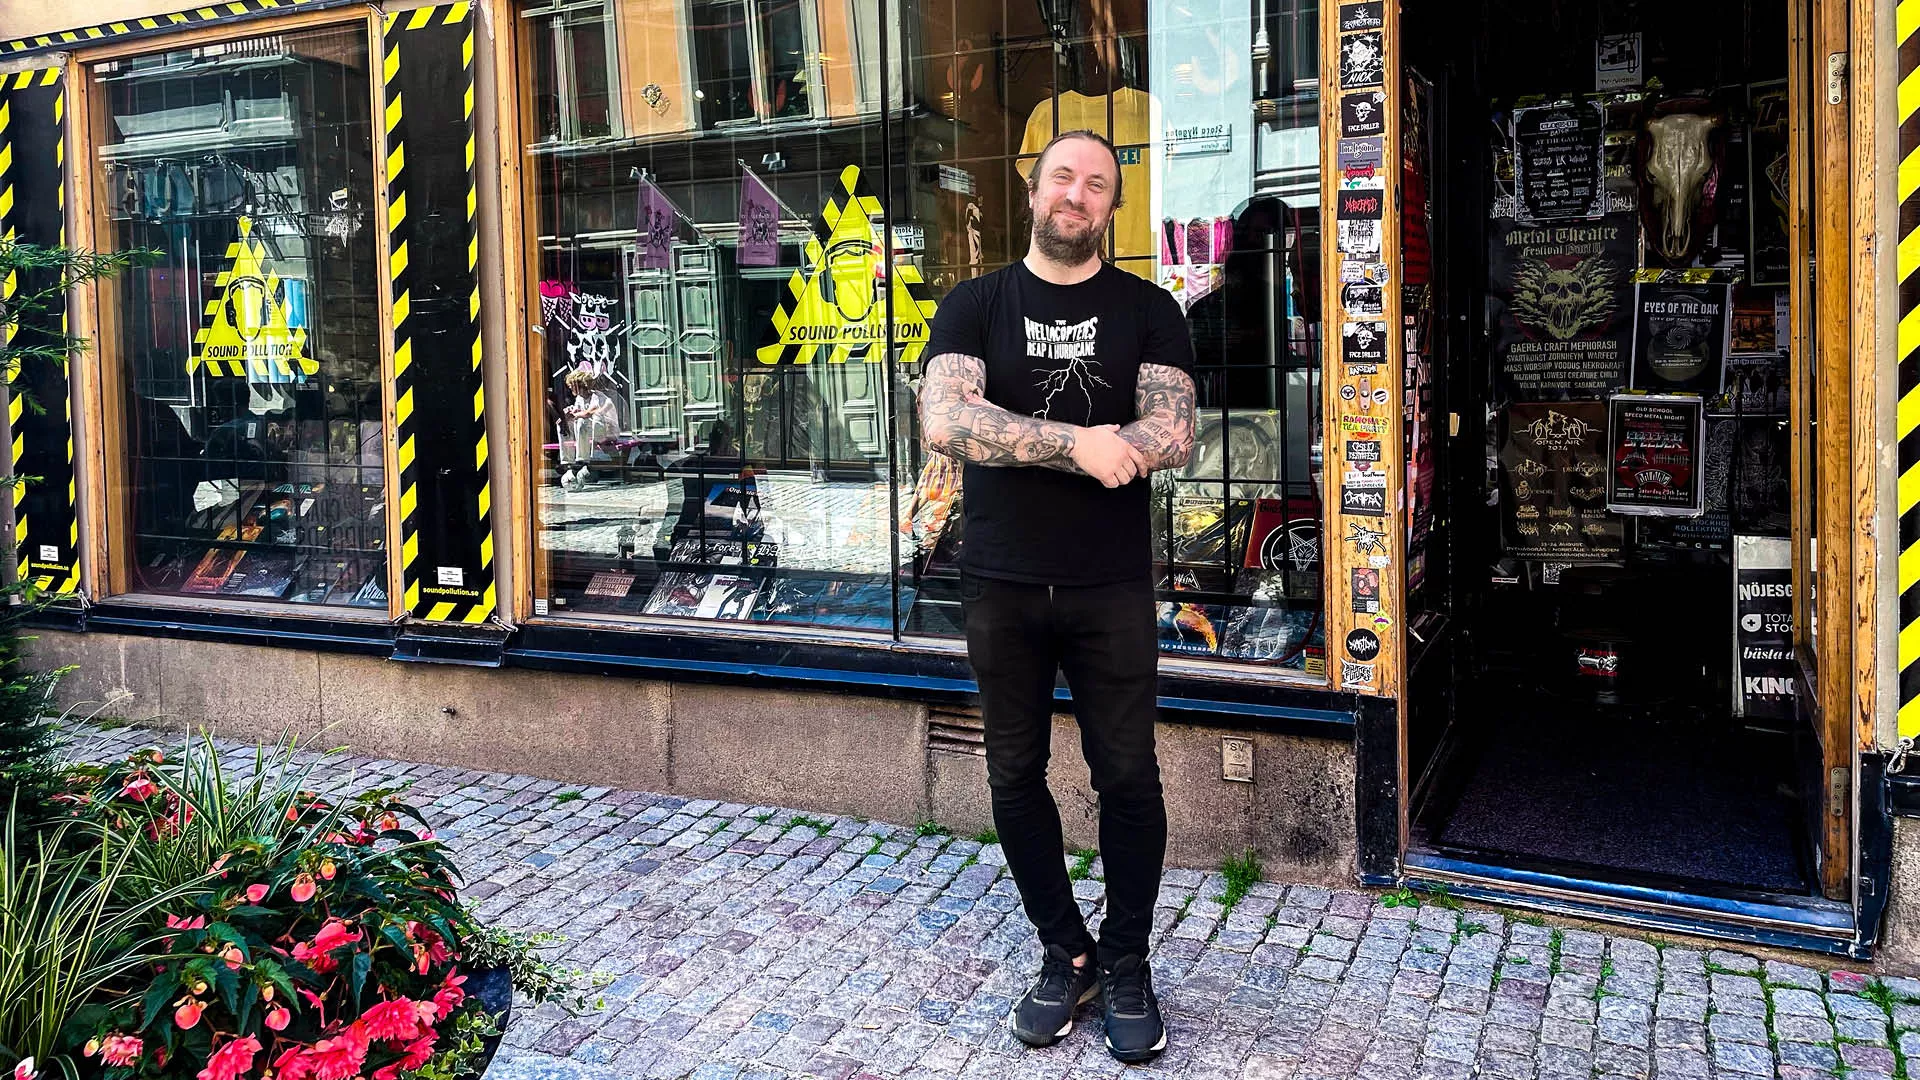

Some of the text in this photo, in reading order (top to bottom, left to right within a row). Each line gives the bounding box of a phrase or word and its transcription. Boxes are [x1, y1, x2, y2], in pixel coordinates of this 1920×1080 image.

[1361, 122, 1380, 130] DRILLER
[1506, 226, 1618, 246] Metal Theatre
[1644, 302, 1719, 315] EYES OF THE OAK
[790, 325, 838, 340] SOUND
[1024, 316, 1098, 342] HELLACOPTERS
[208, 346, 238, 358] SOUND
[1026, 342, 1096, 360] REAP A HURRICANE
[1511, 343, 1542, 353] GAEREA
[1544, 342, 1569, 352] CRAFT
[1504, 364, 1522, 373] MASS
[422, 587, 479, 597] soundpollution.se
[1744, 647, 1783, 660] bästa
